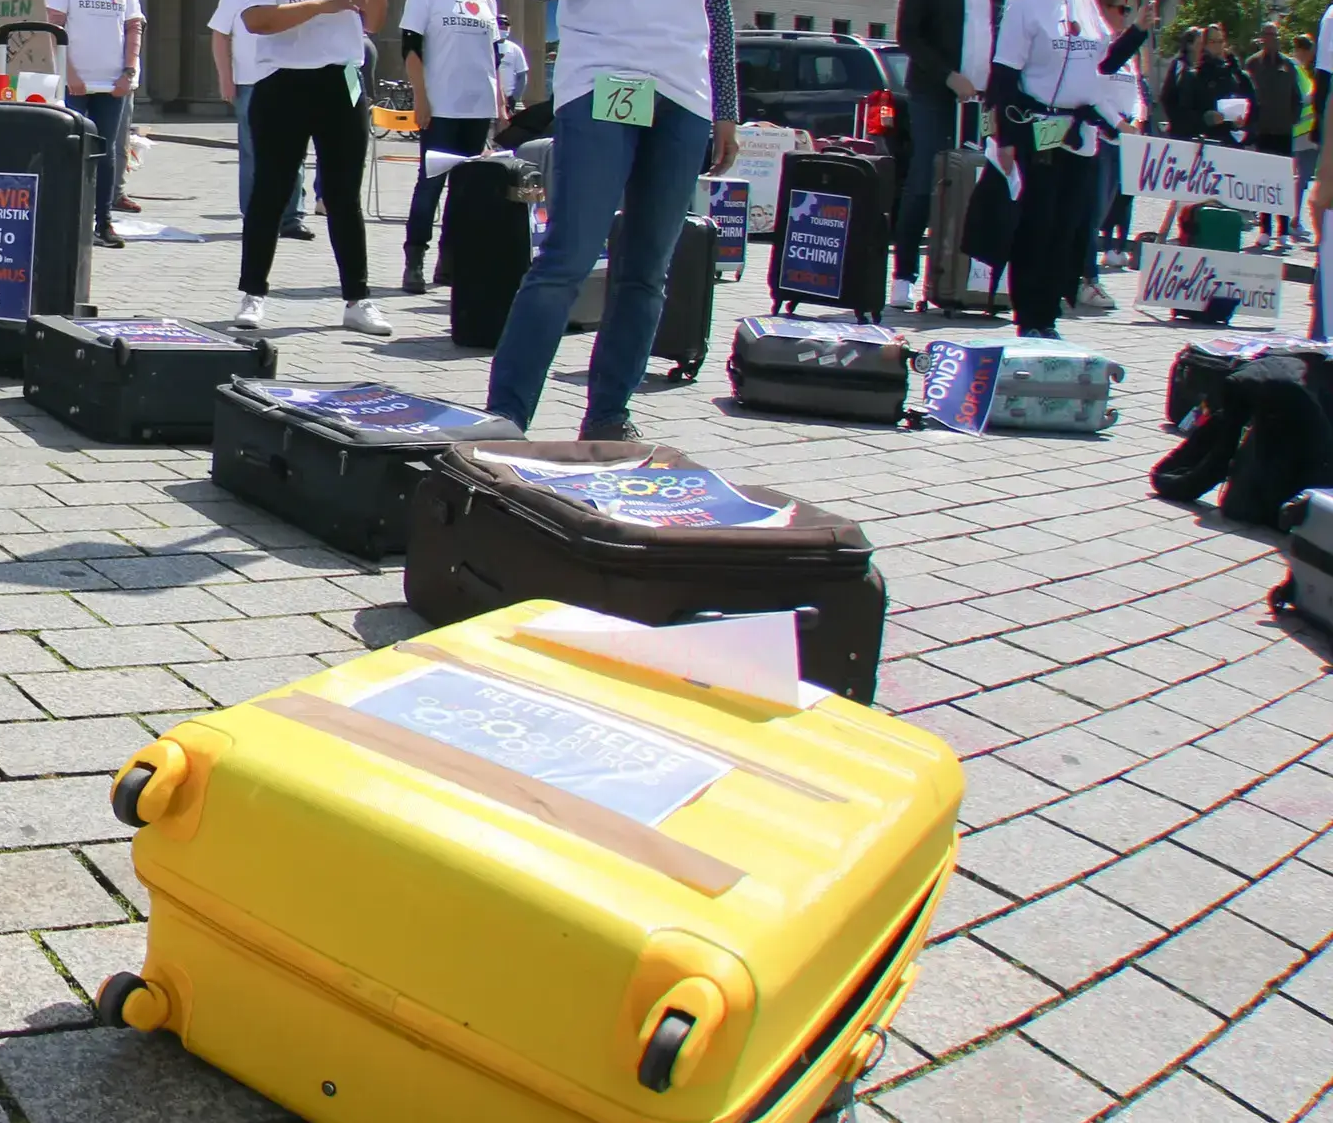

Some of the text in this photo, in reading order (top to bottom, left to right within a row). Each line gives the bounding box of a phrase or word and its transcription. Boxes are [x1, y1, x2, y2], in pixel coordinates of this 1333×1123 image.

[455, 0, 466, 15] I
[1138, 141, 1285, 206] Wörlitz Tourist
[790, 231, 841, 248] RETTUNGS
[810, 216, 845, 229] TOURISTIK
[4, 255, 14, 264] im
[787, 245, 839, 265] SCHIRM
[1143, 250, 1224, 302] Wörlitz
[925, 346, 967, 411] FONDS
[954, 354, 996, 426] SOFORT
[474, 686, 695, 775] RETTET REISE
